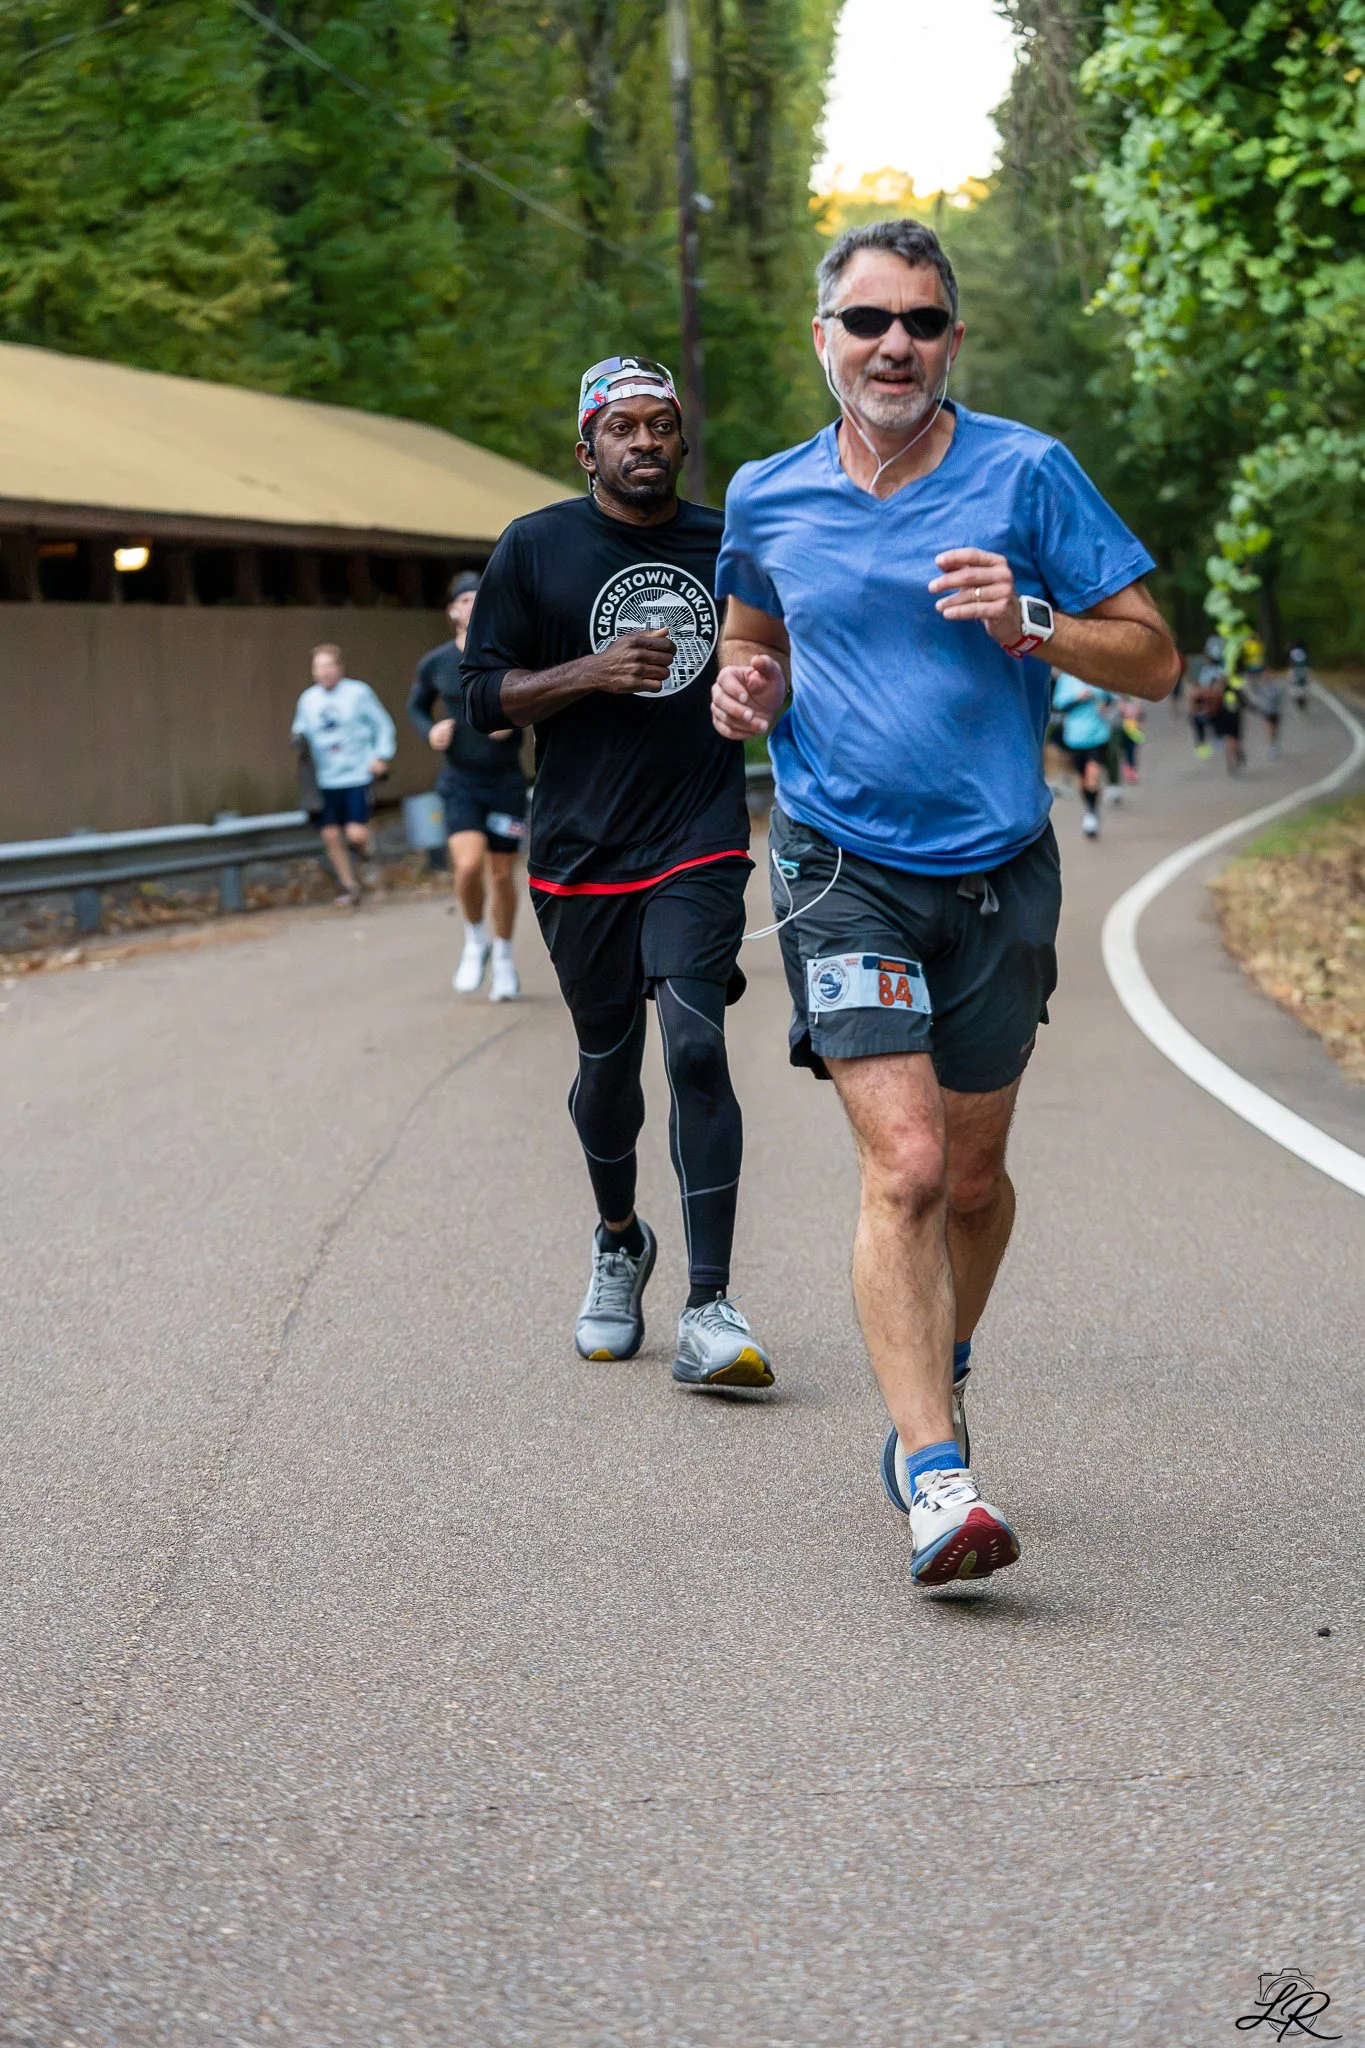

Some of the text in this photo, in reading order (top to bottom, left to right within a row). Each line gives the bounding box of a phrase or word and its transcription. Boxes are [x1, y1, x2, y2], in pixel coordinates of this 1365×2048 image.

[597, 571, 713, 636] CROSSTOWN 10K/5K
[879, 973, 913, 1008] 84
